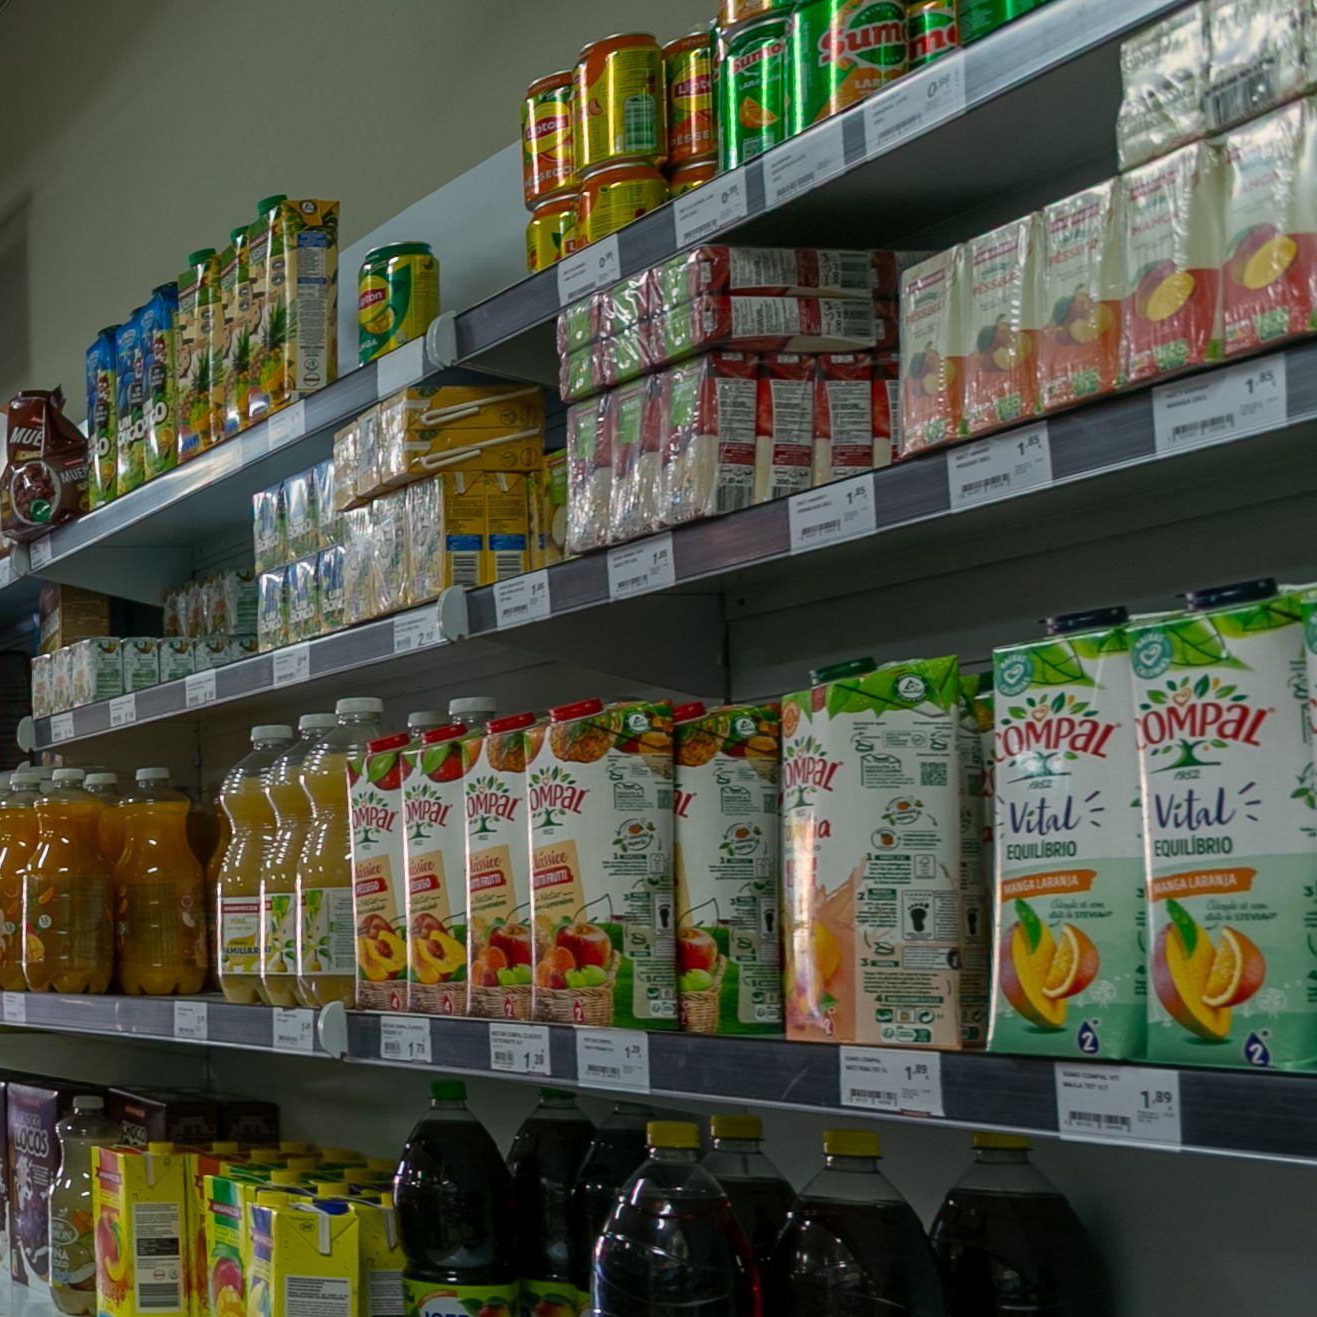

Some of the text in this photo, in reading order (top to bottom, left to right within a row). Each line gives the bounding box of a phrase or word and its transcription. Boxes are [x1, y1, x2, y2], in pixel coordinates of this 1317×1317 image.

[678, 80, 710, 95] Lipto
[360, 291, 382, 307] pton
[1009, 796, 1080, 835] Vital
[1154, 787, 1236, 830] Vital
[1007, 840, 1077, 861] EQUILÍBRIO
[1154, 837, 1232, 857] EQUILÍBRIO
[1003, 875, 1079, 894] MANGA LARANJA
[1152, 874, 1237, 894] MANGA LARANJA
[1082, 1031, 1095, 1051] 2
[1249, 1042, 1265, 1064] 2
[16, 1129, 49, 1158] LOCOS
